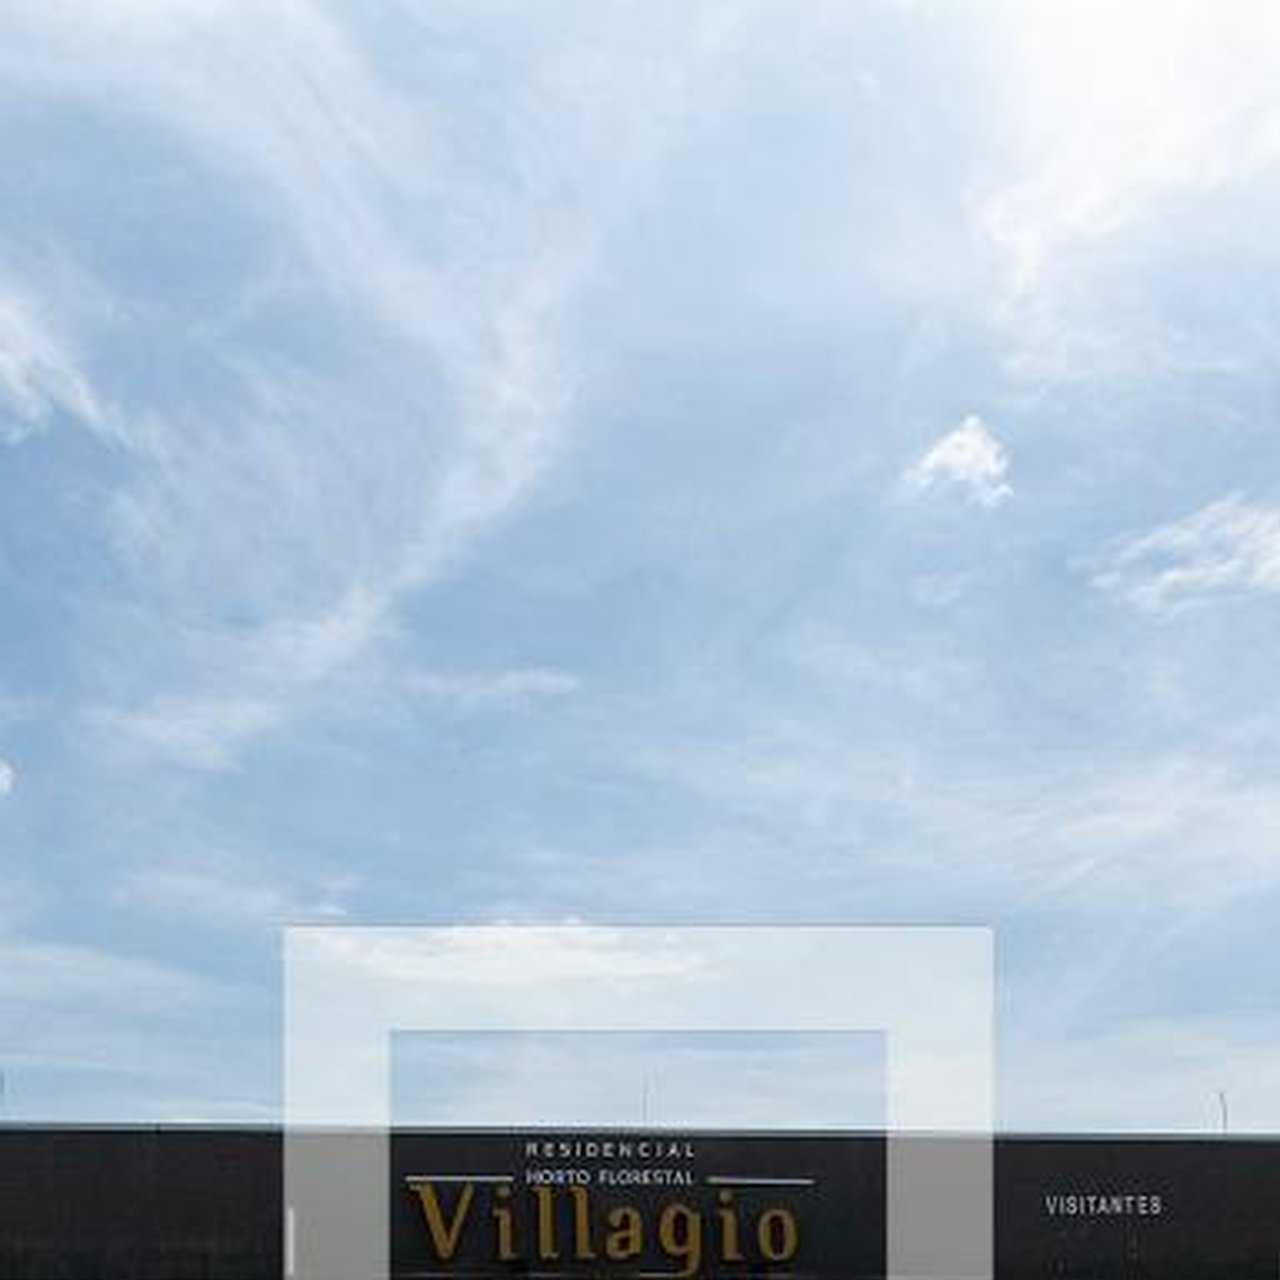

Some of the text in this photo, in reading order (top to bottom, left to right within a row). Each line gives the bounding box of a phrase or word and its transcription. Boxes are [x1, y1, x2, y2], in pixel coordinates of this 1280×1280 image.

[525, 1141, 695, 1158] RESIDENCIAL
[525, 1168, 694, 1185] HORTO FLORESTAL
[1045, 1195, 1161, 1215] VISITANTES
[409, 1182, 798, 1278] Villagio
